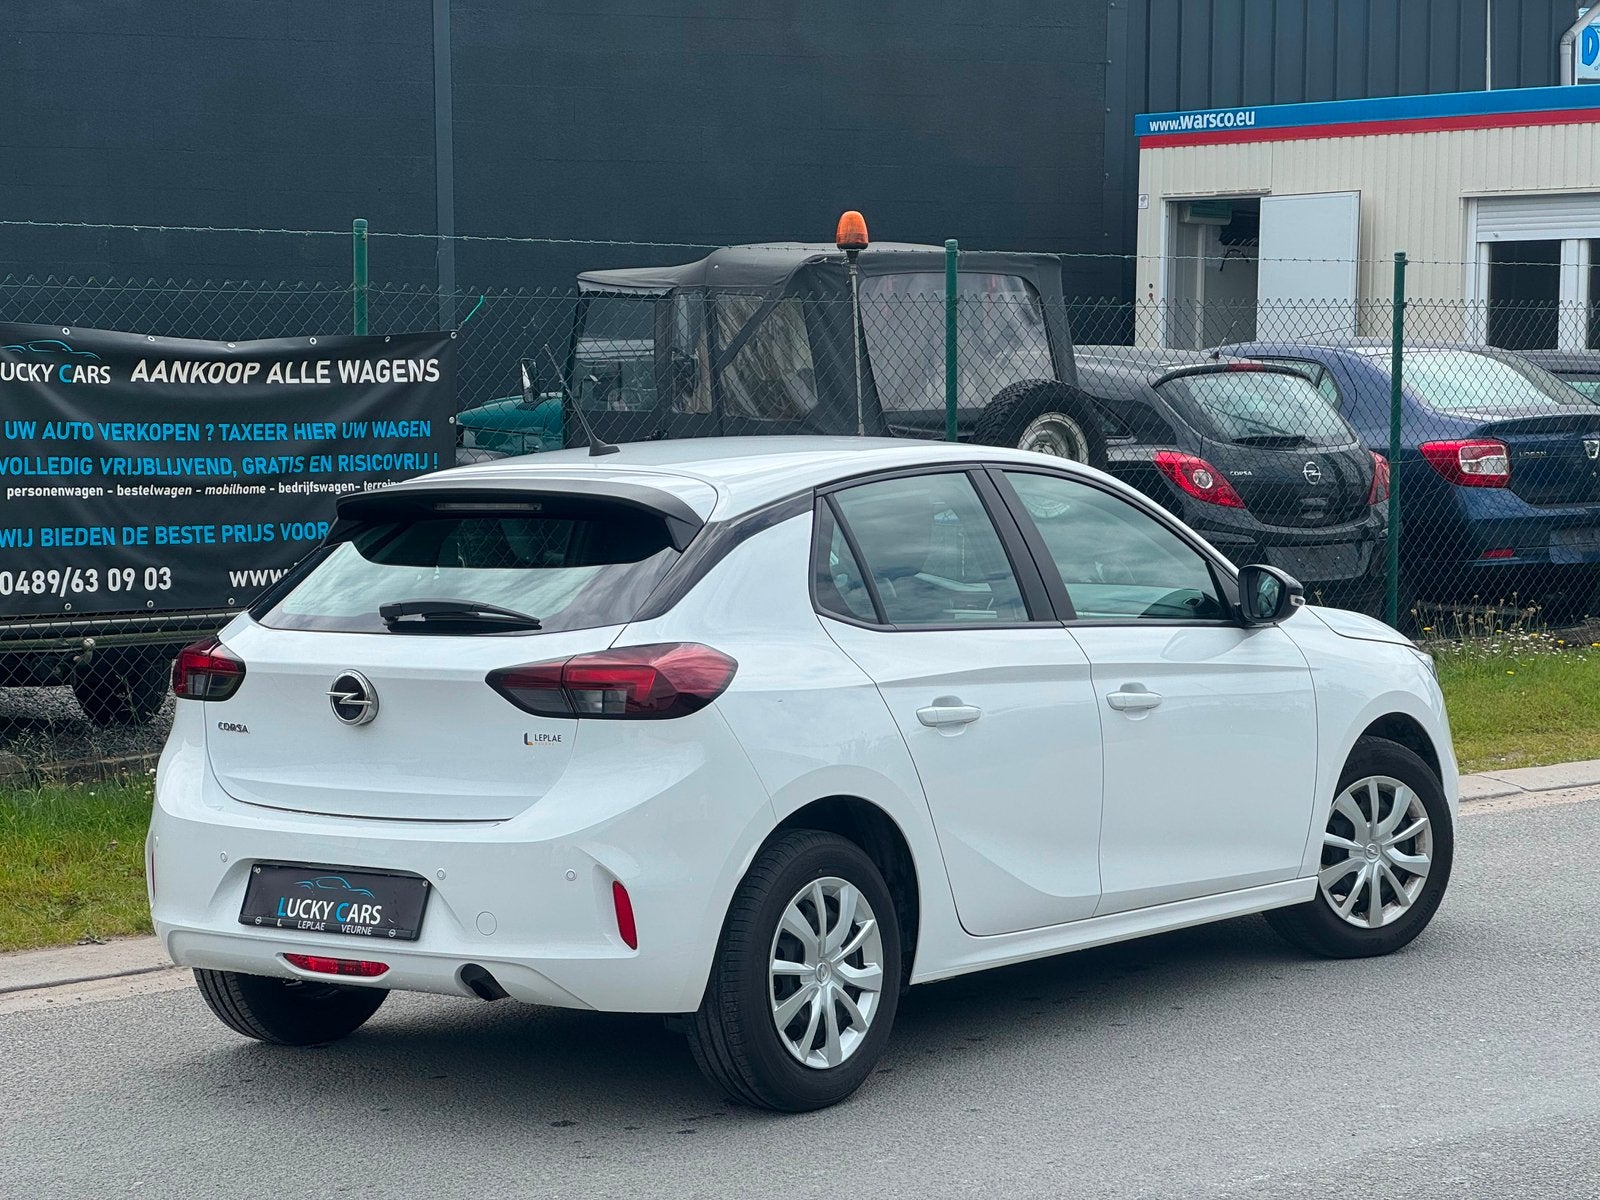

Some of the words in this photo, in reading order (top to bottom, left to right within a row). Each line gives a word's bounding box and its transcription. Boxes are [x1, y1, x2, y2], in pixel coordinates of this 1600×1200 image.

[1582, 27, 1600, 66] D
[1149, 111, 1255, 131] www.warsco.eu
[1, 362, 54, 382] UCKY
[59, 364, 111, 384] CARS
[130, 359, 260, 383] AANKOOP
[266, 361, 331, 383] ALLE
[338, 359, 440, 383] WAGENS
[5, 421, 36, 439] UW
[42, 421, 94, 440] AUTO
[98, 422, 199, 441] VERKOPEN
[205, 423, 214, 440] ?
[219, 424, 287, 441] TAXEER
[293, 423, 336, 439] HIER
[342, 422, 367, 438] UW
[372, 421, 431, 438] WAGEN
[0, 457, 93, 475] VOLLEDIG
[100, 458, 238, 478] VRIJBLIJVEND,
[242, 456, 304, 475] GRATIS
[309, 456, 332, 472] EN
[338, 453, 428, 472] RISICOVRIJ
[433, 453, 438, 470] !
[7, 485, 103, 499] personenwagen
[117, 484, 192, 499] bestelwagen
[205, 484, 266, 495] mobilhome
[0, 529, 33, 548] WIJ
[41, 527, 115, 547] BIEDEN
[122, 527, 148, 545] DE
[155, 525, 215, 544] BESTE
[222, 523, 275, 543] PRIJS
[280, 522, 329, 540] VOOR
[0, 567, 98, 597] 0489/63
[108, 568, 135, 591] 09
[144, 567, 171, 590] 03
[217, 721, 249, 733] CORSA
[534, 734, 562, 742] LEPLAE
[277, 897, 334, 920] LUCKY
[335, 903, 382, 925] CARS
[298, 921, 325, 931] LEPLAE
[341, 924, 372, 935] VEURNE
